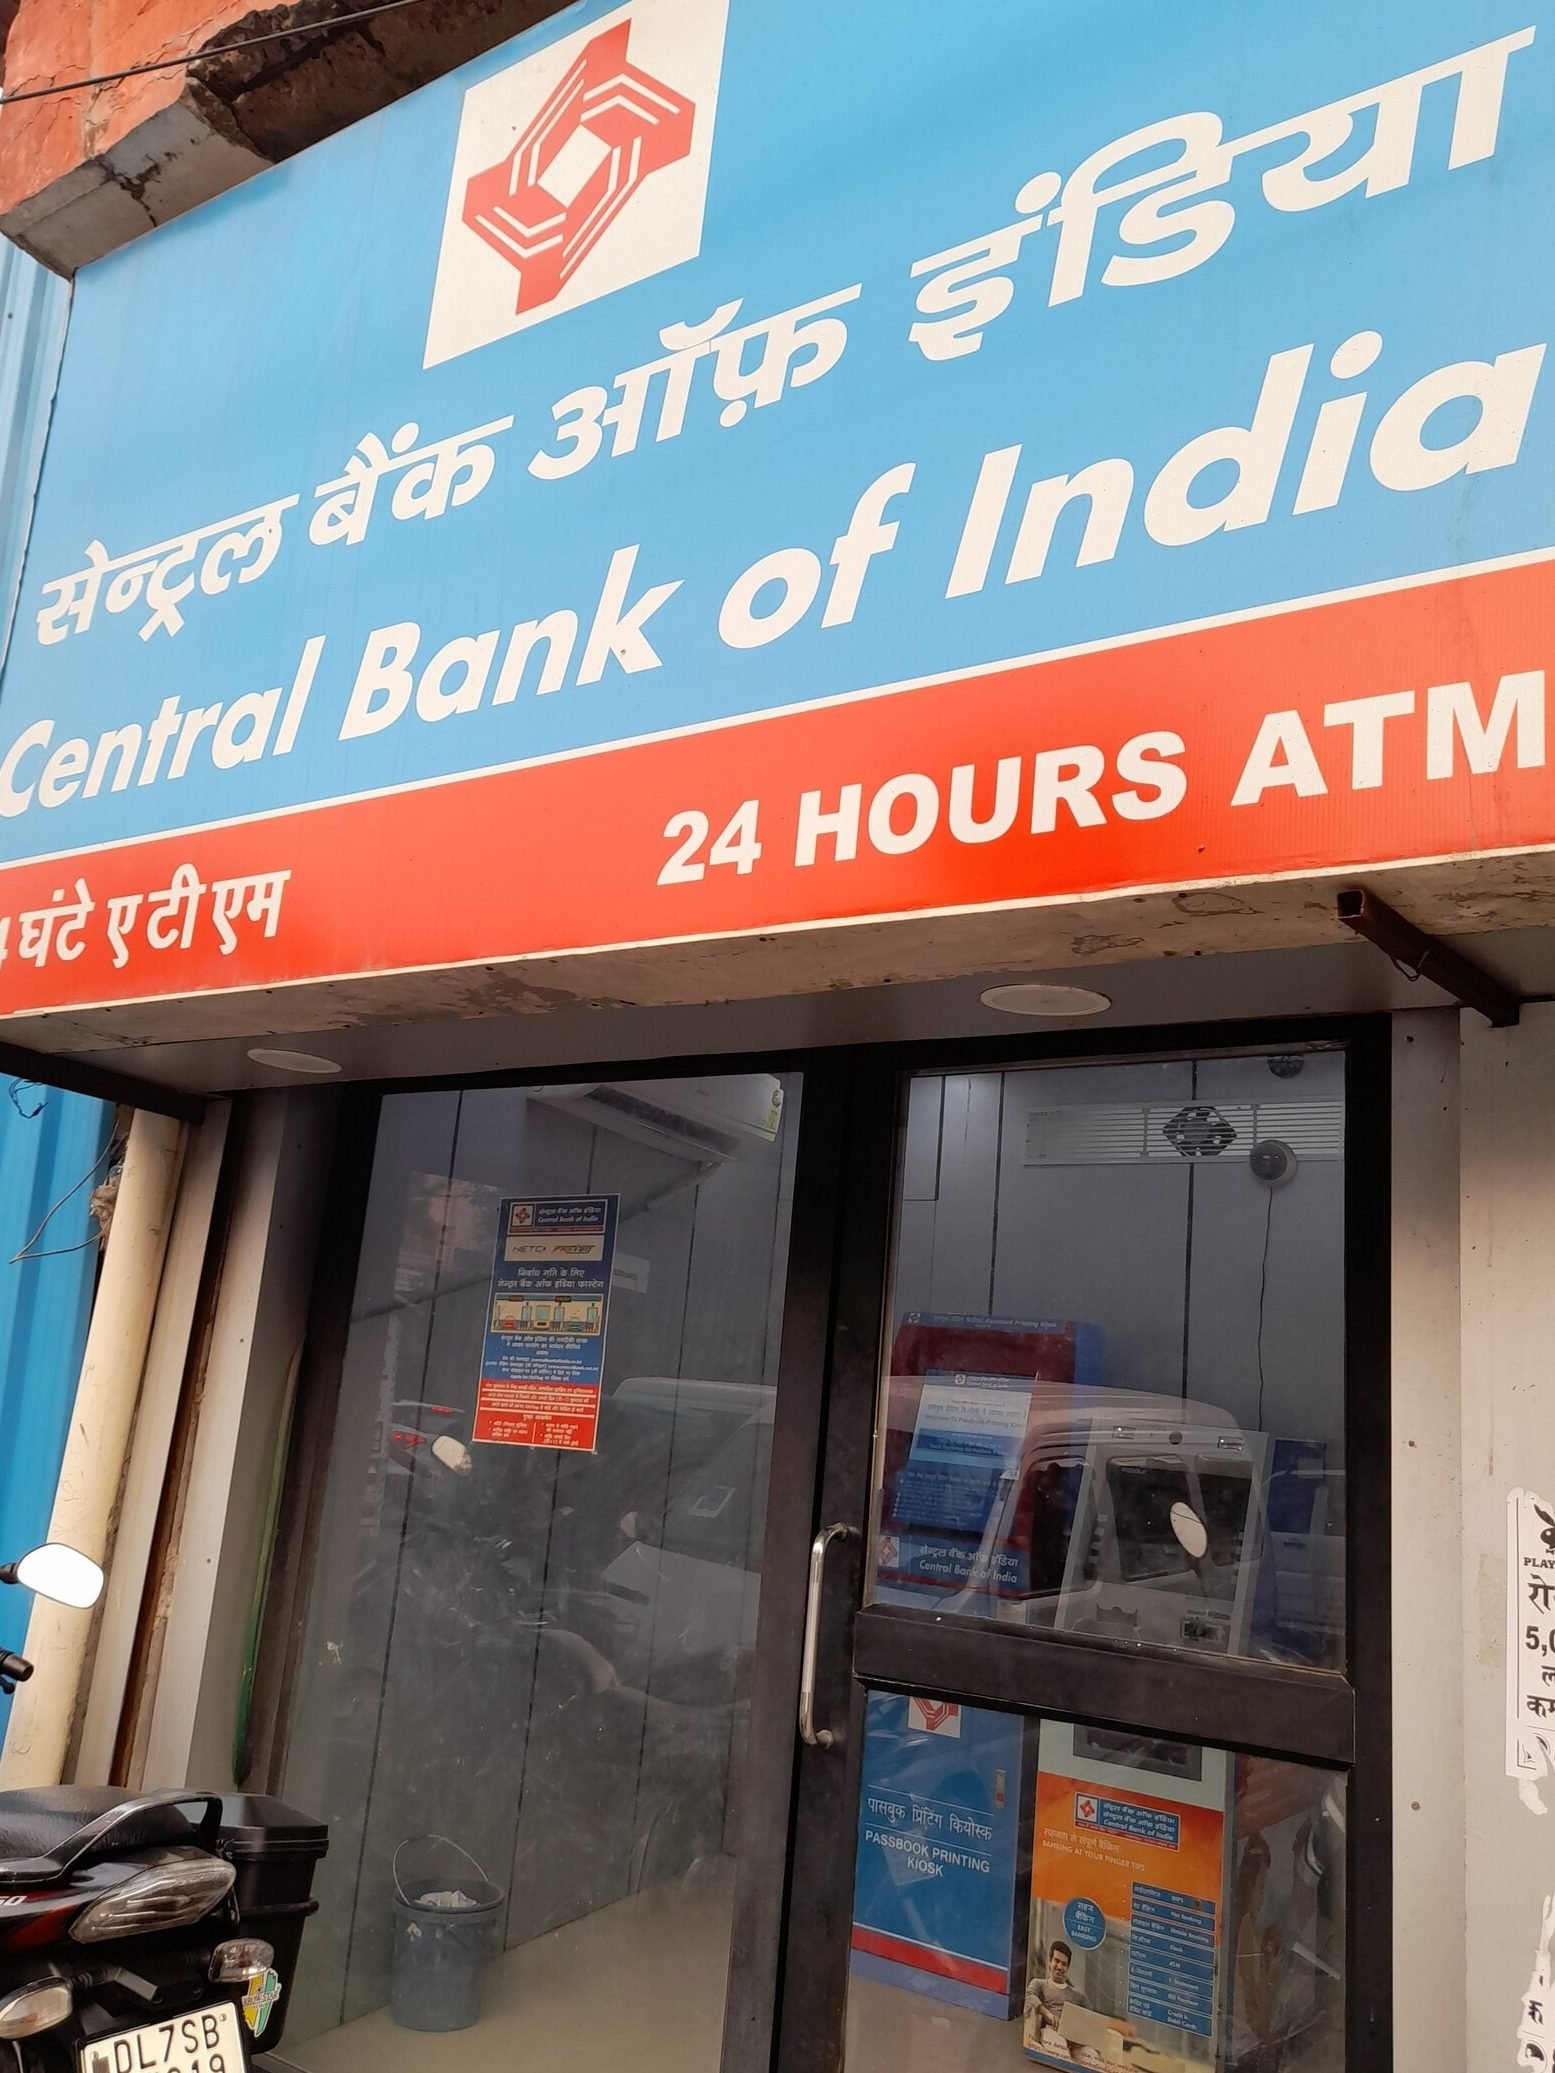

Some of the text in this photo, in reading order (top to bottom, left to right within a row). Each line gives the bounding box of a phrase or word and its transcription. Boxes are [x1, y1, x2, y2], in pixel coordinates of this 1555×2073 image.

[36, 494, 300, 646] सेन्ट्रल
[308, 422, 515, 547] बैंक
[908, 25, 1537, 361] इंडिया
[0, 330, 1548, 818] Central Bank of India
[656, 669, 1547, 887] 24 HOURS ATM
[18, 877, 96, 968] घंटे
[919, 1560, 1018, 1583] Central Bank of India
[867, 1797, 907, 1823] पासबुक
[949, 1813, 993, 1841] कियोस्क
[1103, 1818, 1128, 1831] Central
[1128, 1825, 1147, 1835] Bank
[1156, 1831, 1175, 1841] India
[865, 1830, 990, 1873] PASSBOOK PRINTING
[907, 1857, 945, 1877] KIOSK
[1042, 1839, 1146, 1872] BANKING AT YOUR FINGER TIPS
[1070, 1930, 1098, 1943] BANKING
[112, 2012, 221, 2073] DL7SB
